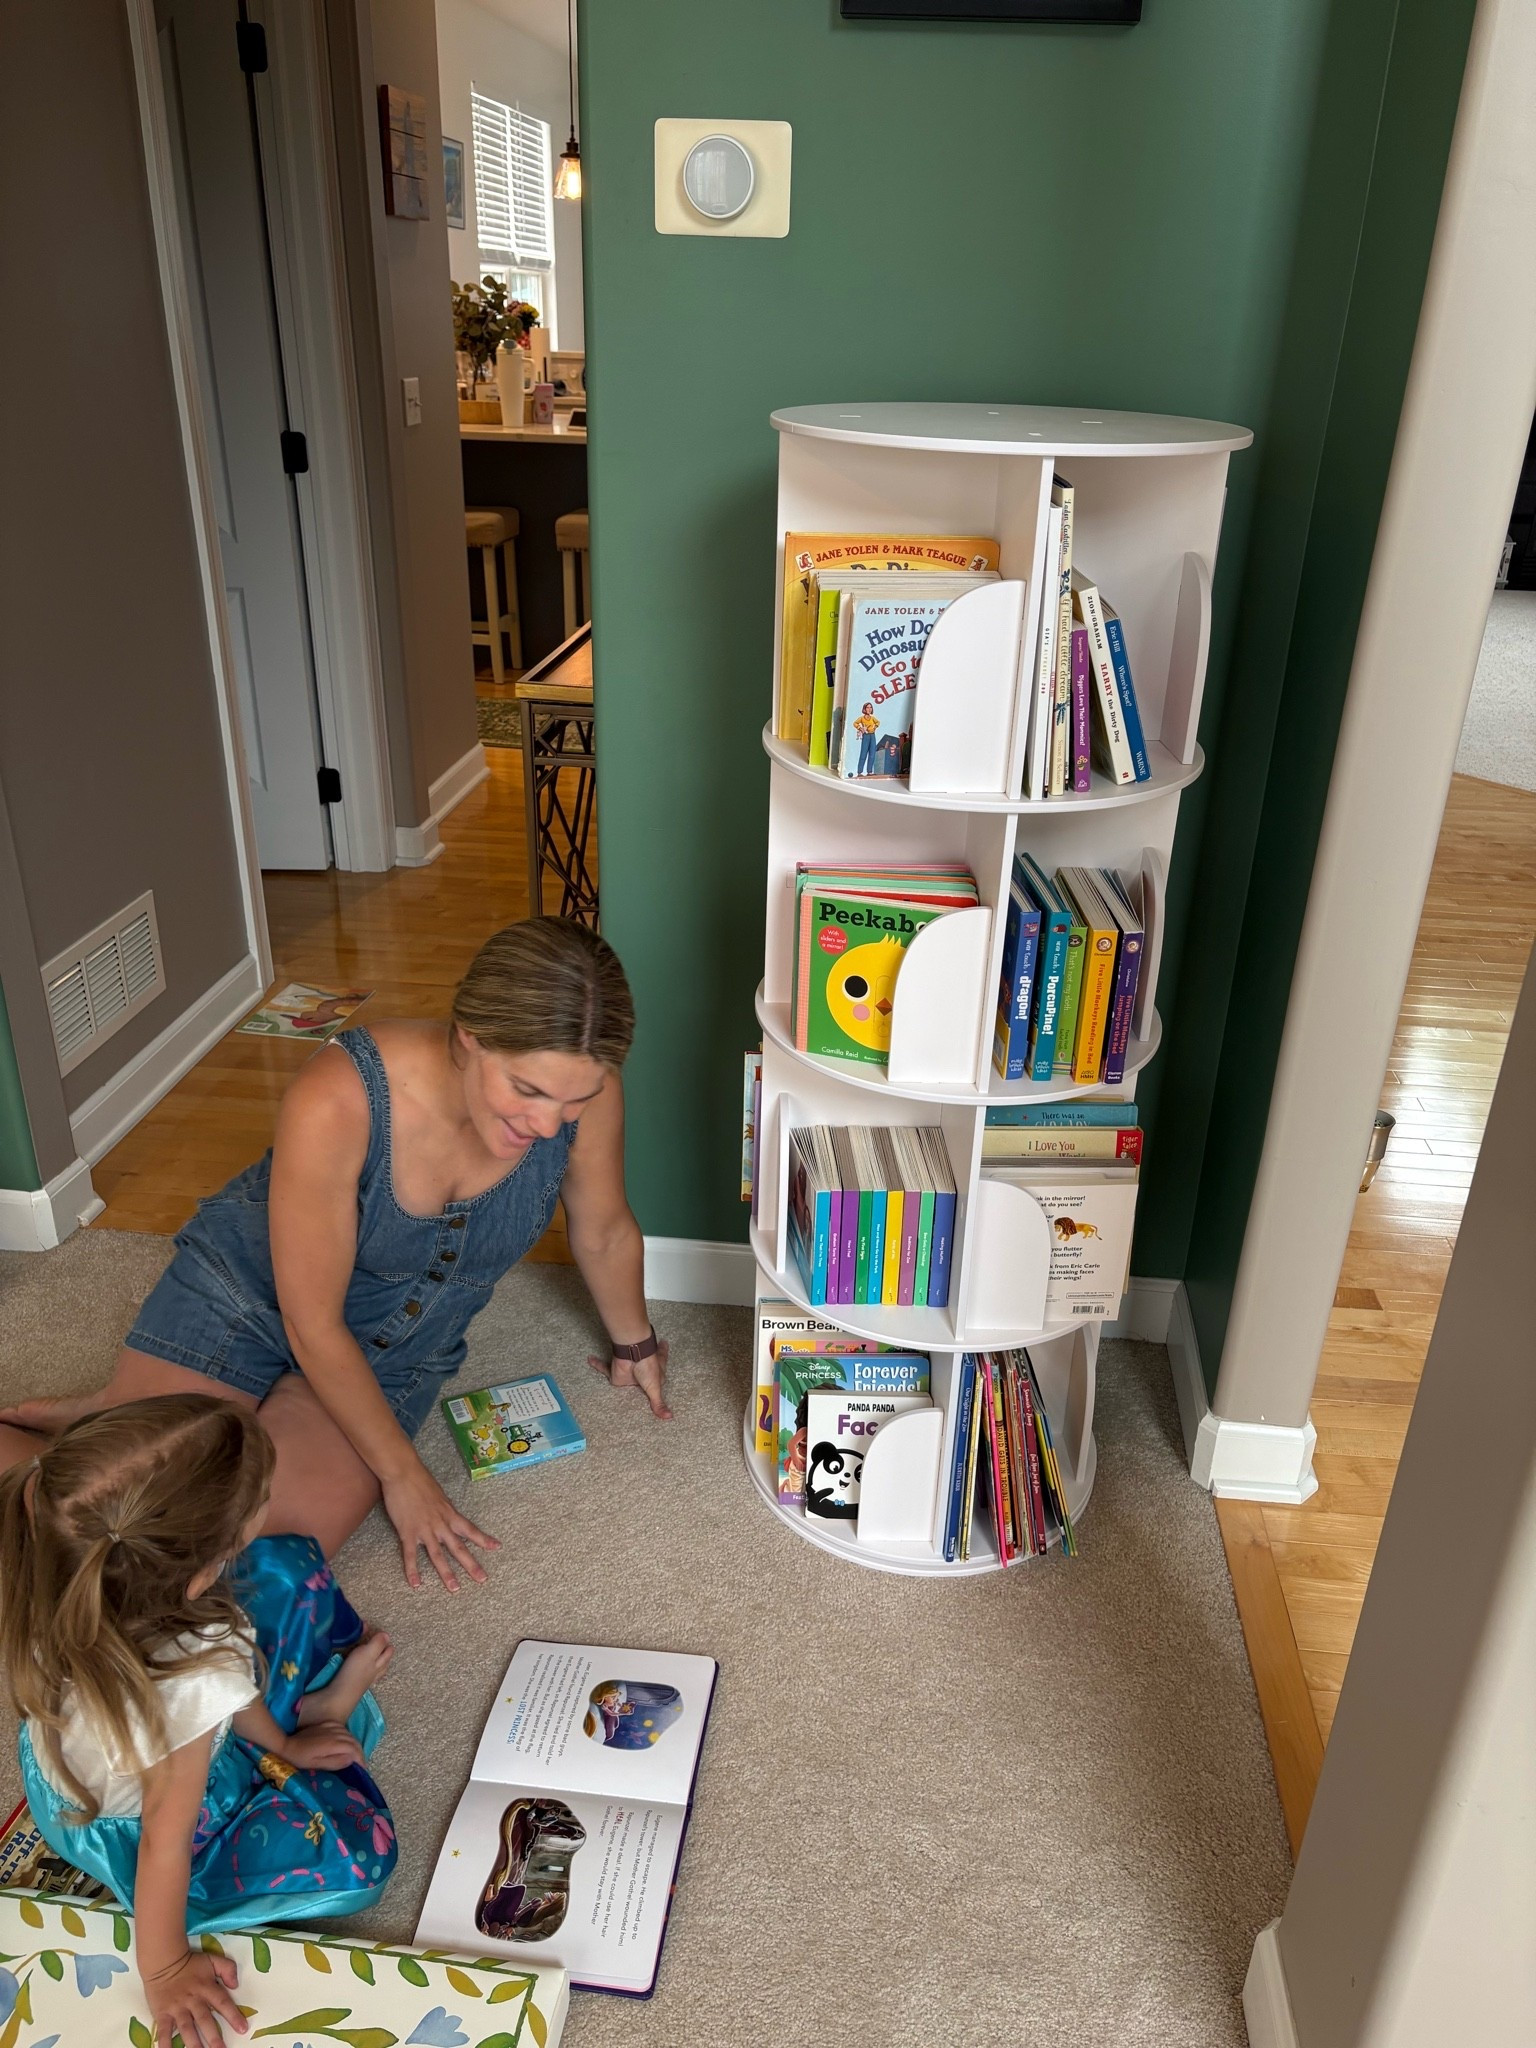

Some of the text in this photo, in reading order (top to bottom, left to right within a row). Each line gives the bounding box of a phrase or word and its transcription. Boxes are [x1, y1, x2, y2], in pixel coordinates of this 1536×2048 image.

[816, 549, 842, 562] JANE
[845, 545, 879, 556] YOLEN
[882, 545, 890, 553] &
[892, 545, 923, 556] MARK
[927, 549, 967, 567] TEAGUE
[1060, 615, 1069, 632] had
[1087, 596, 1104, 650] ZION/GRAHAM
[865, 625, 905, 648] How
[1110, 625, 1121, 653] Eric Hill
[858, 639, 926, 672] Dinosau
[1060, 646, 1069, 666] little
[881, 661, 906, 677] Go
[871, 674, 916, 704] SLEE
[1059, 670, 1069, 701] dream
[1077, 674, 1086, 694] Diggers
[1118, 665, 1132, 707] Where's Spot?
[1100, 663, 1121, 743] HARRY the Dirty Dog
[1078, 721, 1086, 746] Mommies!
[1136, 751, 1146, 776] WARNE
[820, 934, 836, 942] sliders
[1068, 951, 1078, 969] That's
[1098, 964, 1106, 976] Five
[1063, 984, 1070, 994] my
[1096, 977, 1104, 993] Little
[1015, 975, 1032, 1020] dragon!
[1092, 994, 1102, 1021] Monkeys
[1115, 994, 1124, 1021] Jumping
[1123, 1009, 1131, 1024] Little
[1088, 1022, 1098, 1045] Reading
[1115, 1022, 1120, 1030] on
[1119, 1026, 1129, 1053] Monkeys
[821, 1046, 859, 1058] Camilla Reid
[1086, 1053, 1094, 1064] Bed
[1042, 1112, 1060, 1120] There
[1028, 1140, 1075, 1151] I Love You
[762, 1320, 804, 1329] Brown
[807, 1362, 831, 1371] Disney
[854, 1363, 918, 1379] Forever
[854, 1379, 921, 1392] Friends!
[848, 1403, 895, 1413] PANDA PANDA
[838, 1414, 878, 1436] Fac
[998, 1451, 1006, 1465] GETS
[517, 1700, 527, 1714] LOST
[613, 1810, 624, 1825] HEAL
[619, 1831, 627, 1847] made
[646, 1831, 658, 1856] managed
[0, 1830, 27, 1866] Rac
[601, 1857, 610, 1875] would
[615, 1851, 624, 1866] deal.
[611, 1871, 619, 1882] she
[630, 1857, 640, 1879] Mother
[597, 1874, 606, 1887] stay
[595, 1887, 604, 1901] with
[608, 1882, 617, 1900] could
[625, 1879, 636, 1900] Gothel
[639, 1886, 646, 1895] He
[590, 1901, 601, 1925] Mother
[619, 1900, 632, 1931] wounded
[633, 1896, 645, 1921] climbed
[603, 1912, 611, 1924] her
[631, 1922, 638, 1931] up
[600, 1924, 608, 1938] hair
[617, 1931, 627, 1947] him!
